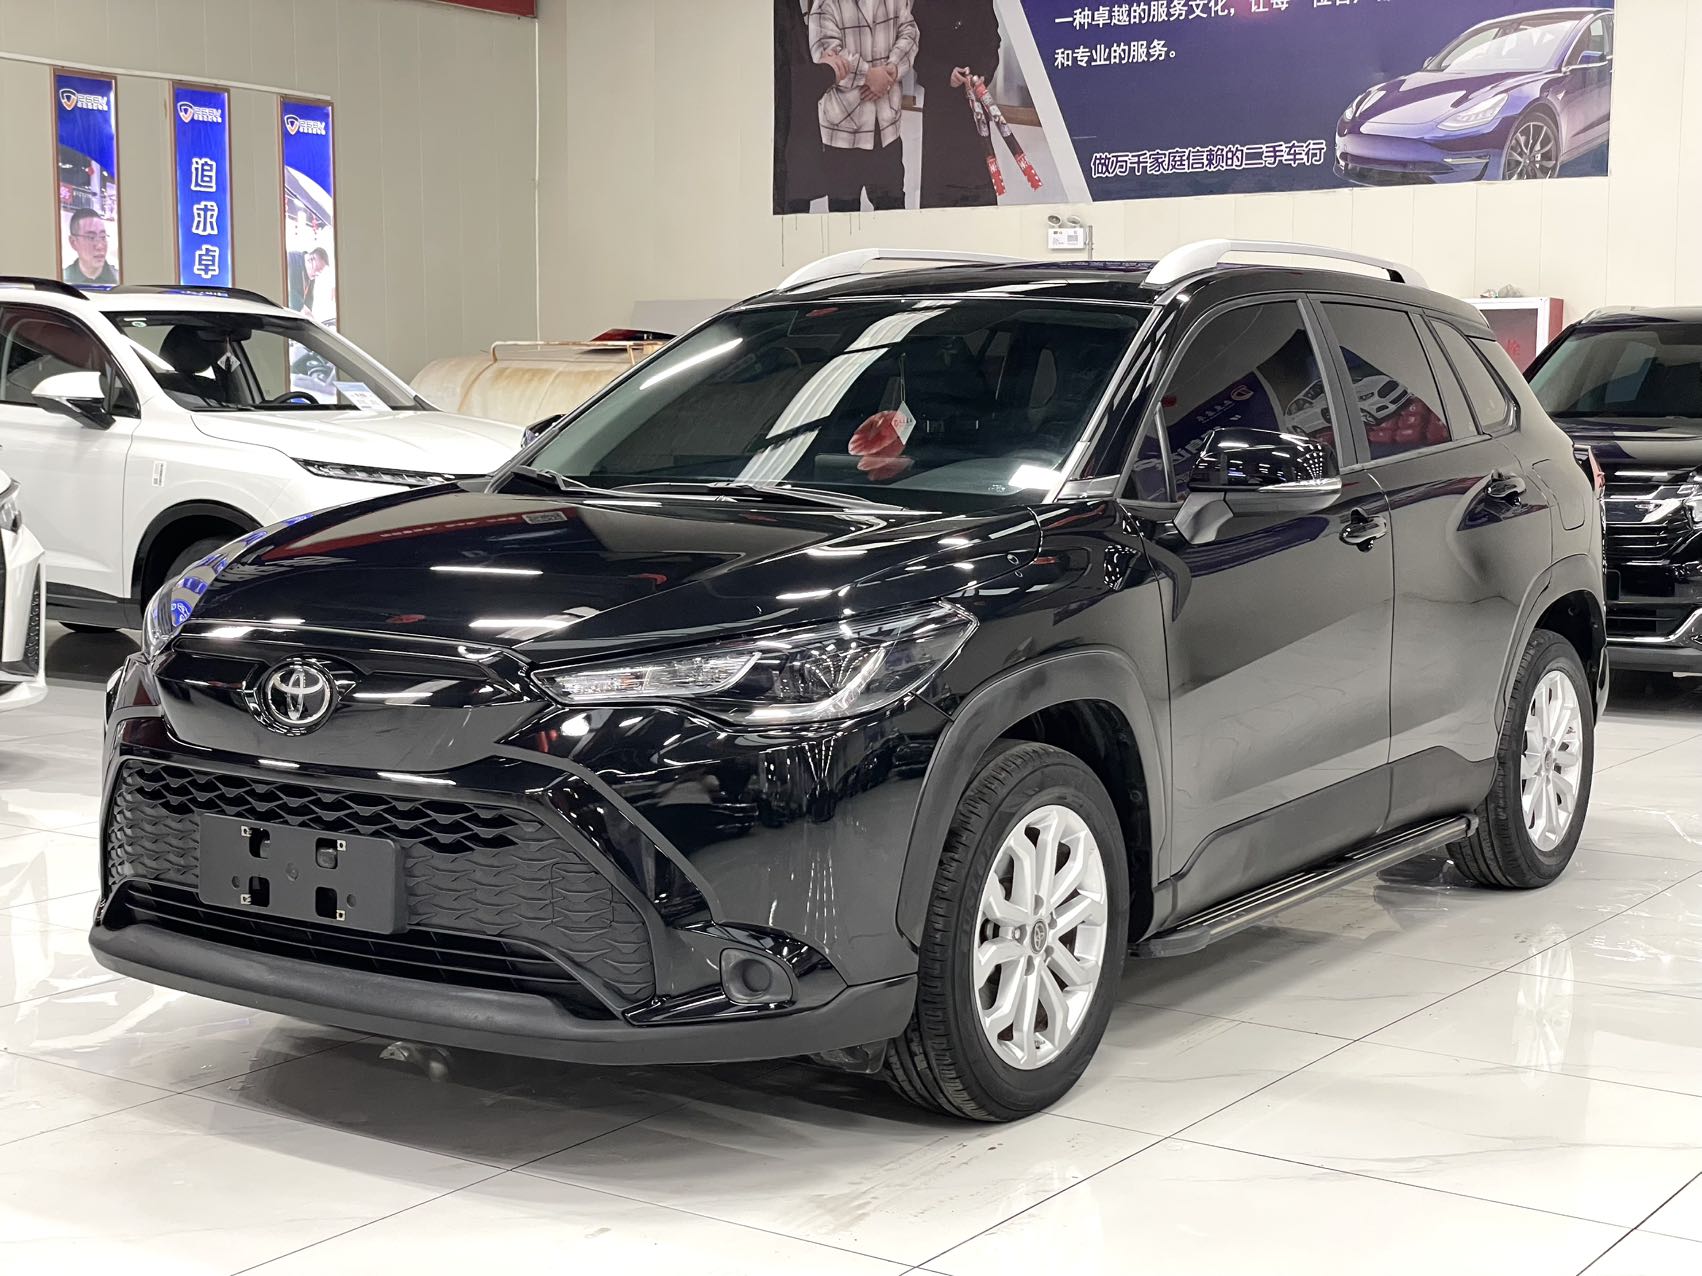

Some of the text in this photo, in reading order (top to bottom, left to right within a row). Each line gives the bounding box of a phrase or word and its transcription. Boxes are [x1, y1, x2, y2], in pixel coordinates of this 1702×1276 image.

[1054, 39, 1176, 69] 和专业的服务。
[1091, 140, 1326, 178] 做万千家庭信赖的二手车行
[191, 158, 219, 278] 追求卓
